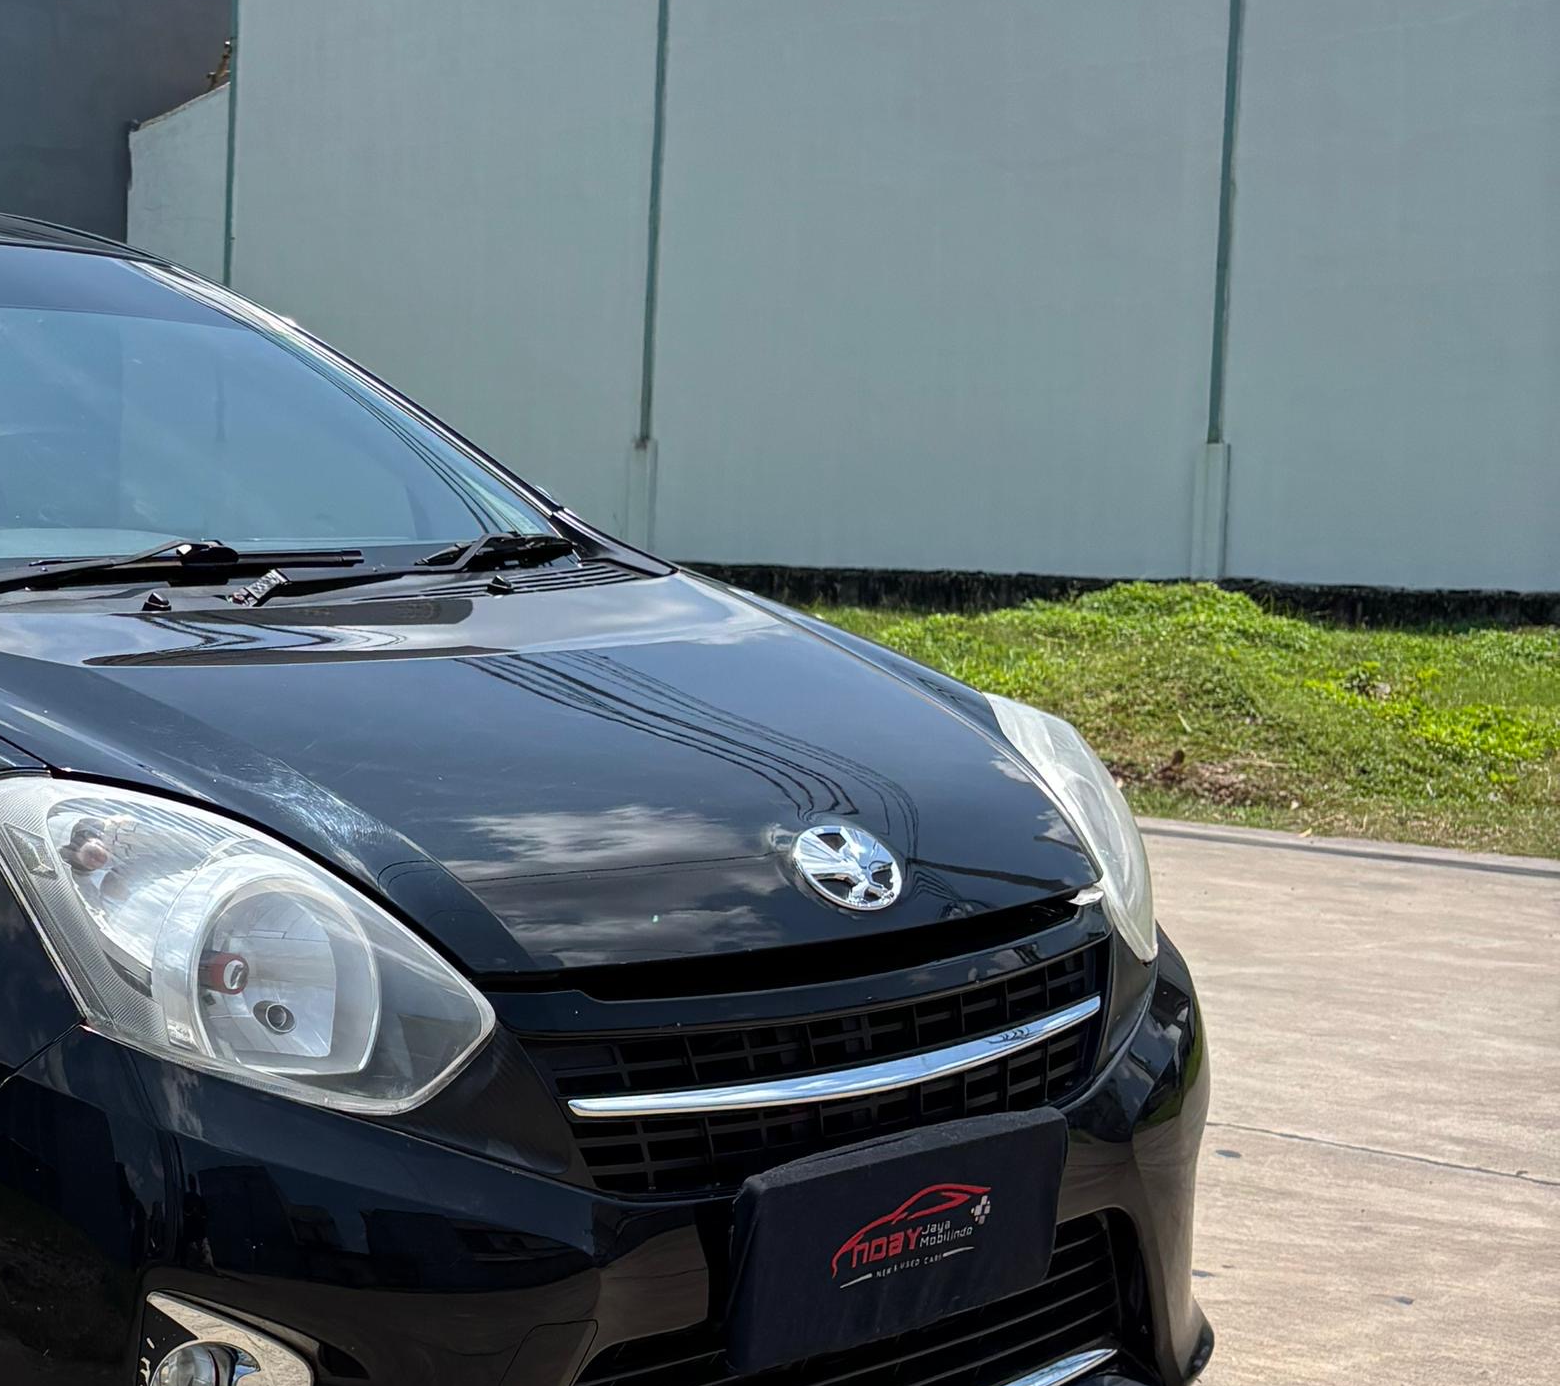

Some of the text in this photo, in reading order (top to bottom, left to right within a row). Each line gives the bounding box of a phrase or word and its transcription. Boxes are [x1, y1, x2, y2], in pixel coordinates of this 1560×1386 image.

[921, 1220, 951, 1235] Jaya
[919, 1226, 973, 1248] Mobilindo
[900, 1258, 920, 1269] USED
